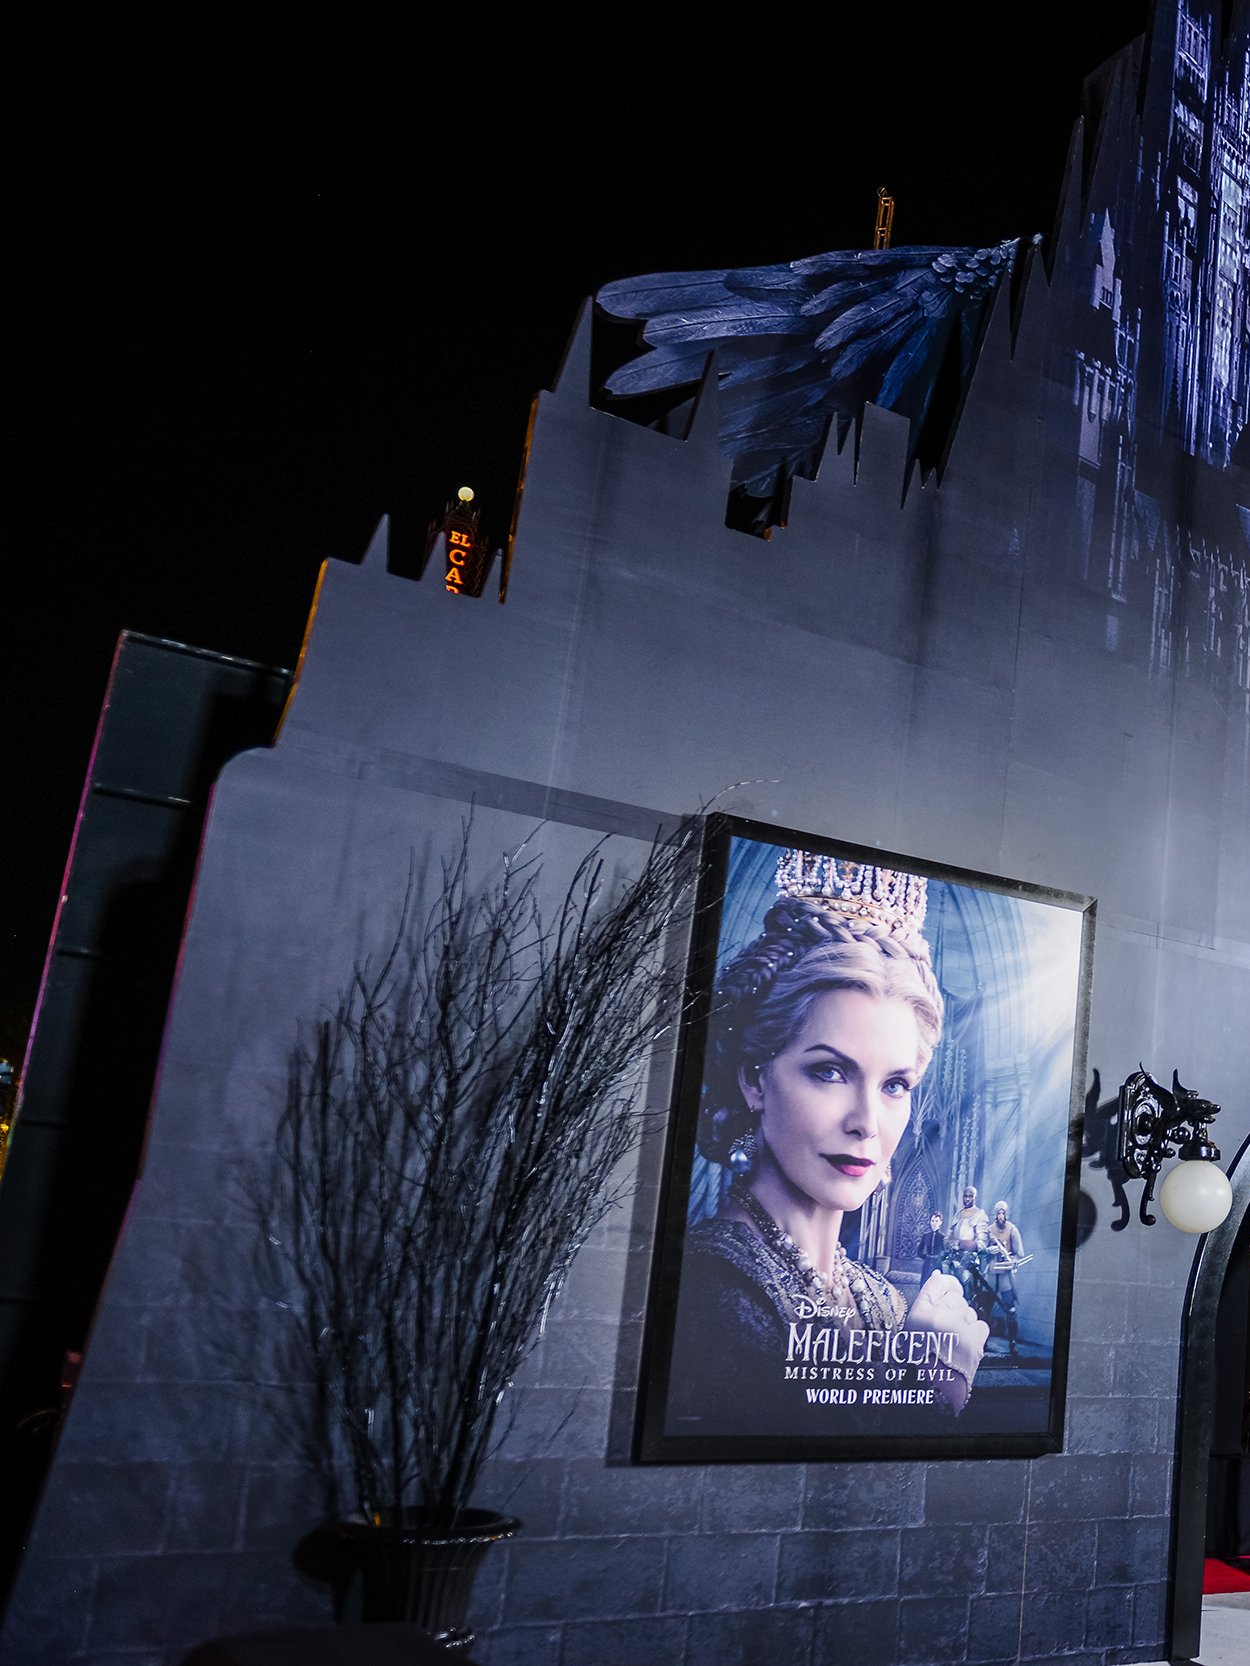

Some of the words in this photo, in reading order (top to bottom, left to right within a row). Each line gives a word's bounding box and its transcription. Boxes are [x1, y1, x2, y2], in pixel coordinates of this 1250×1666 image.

[449, 531, 471, 547] EL
[785, 1322, 960, 1368] MALEFICENT
[784, 1367, 875, 1380] MISTRESS
[885, 1368, 907, 1382] OF
[917, 1367, 955, 1382] EVIL
[806, 1388, 857, 1405] WORLD
[863, 1389, 934, 1405] PREMIERE
